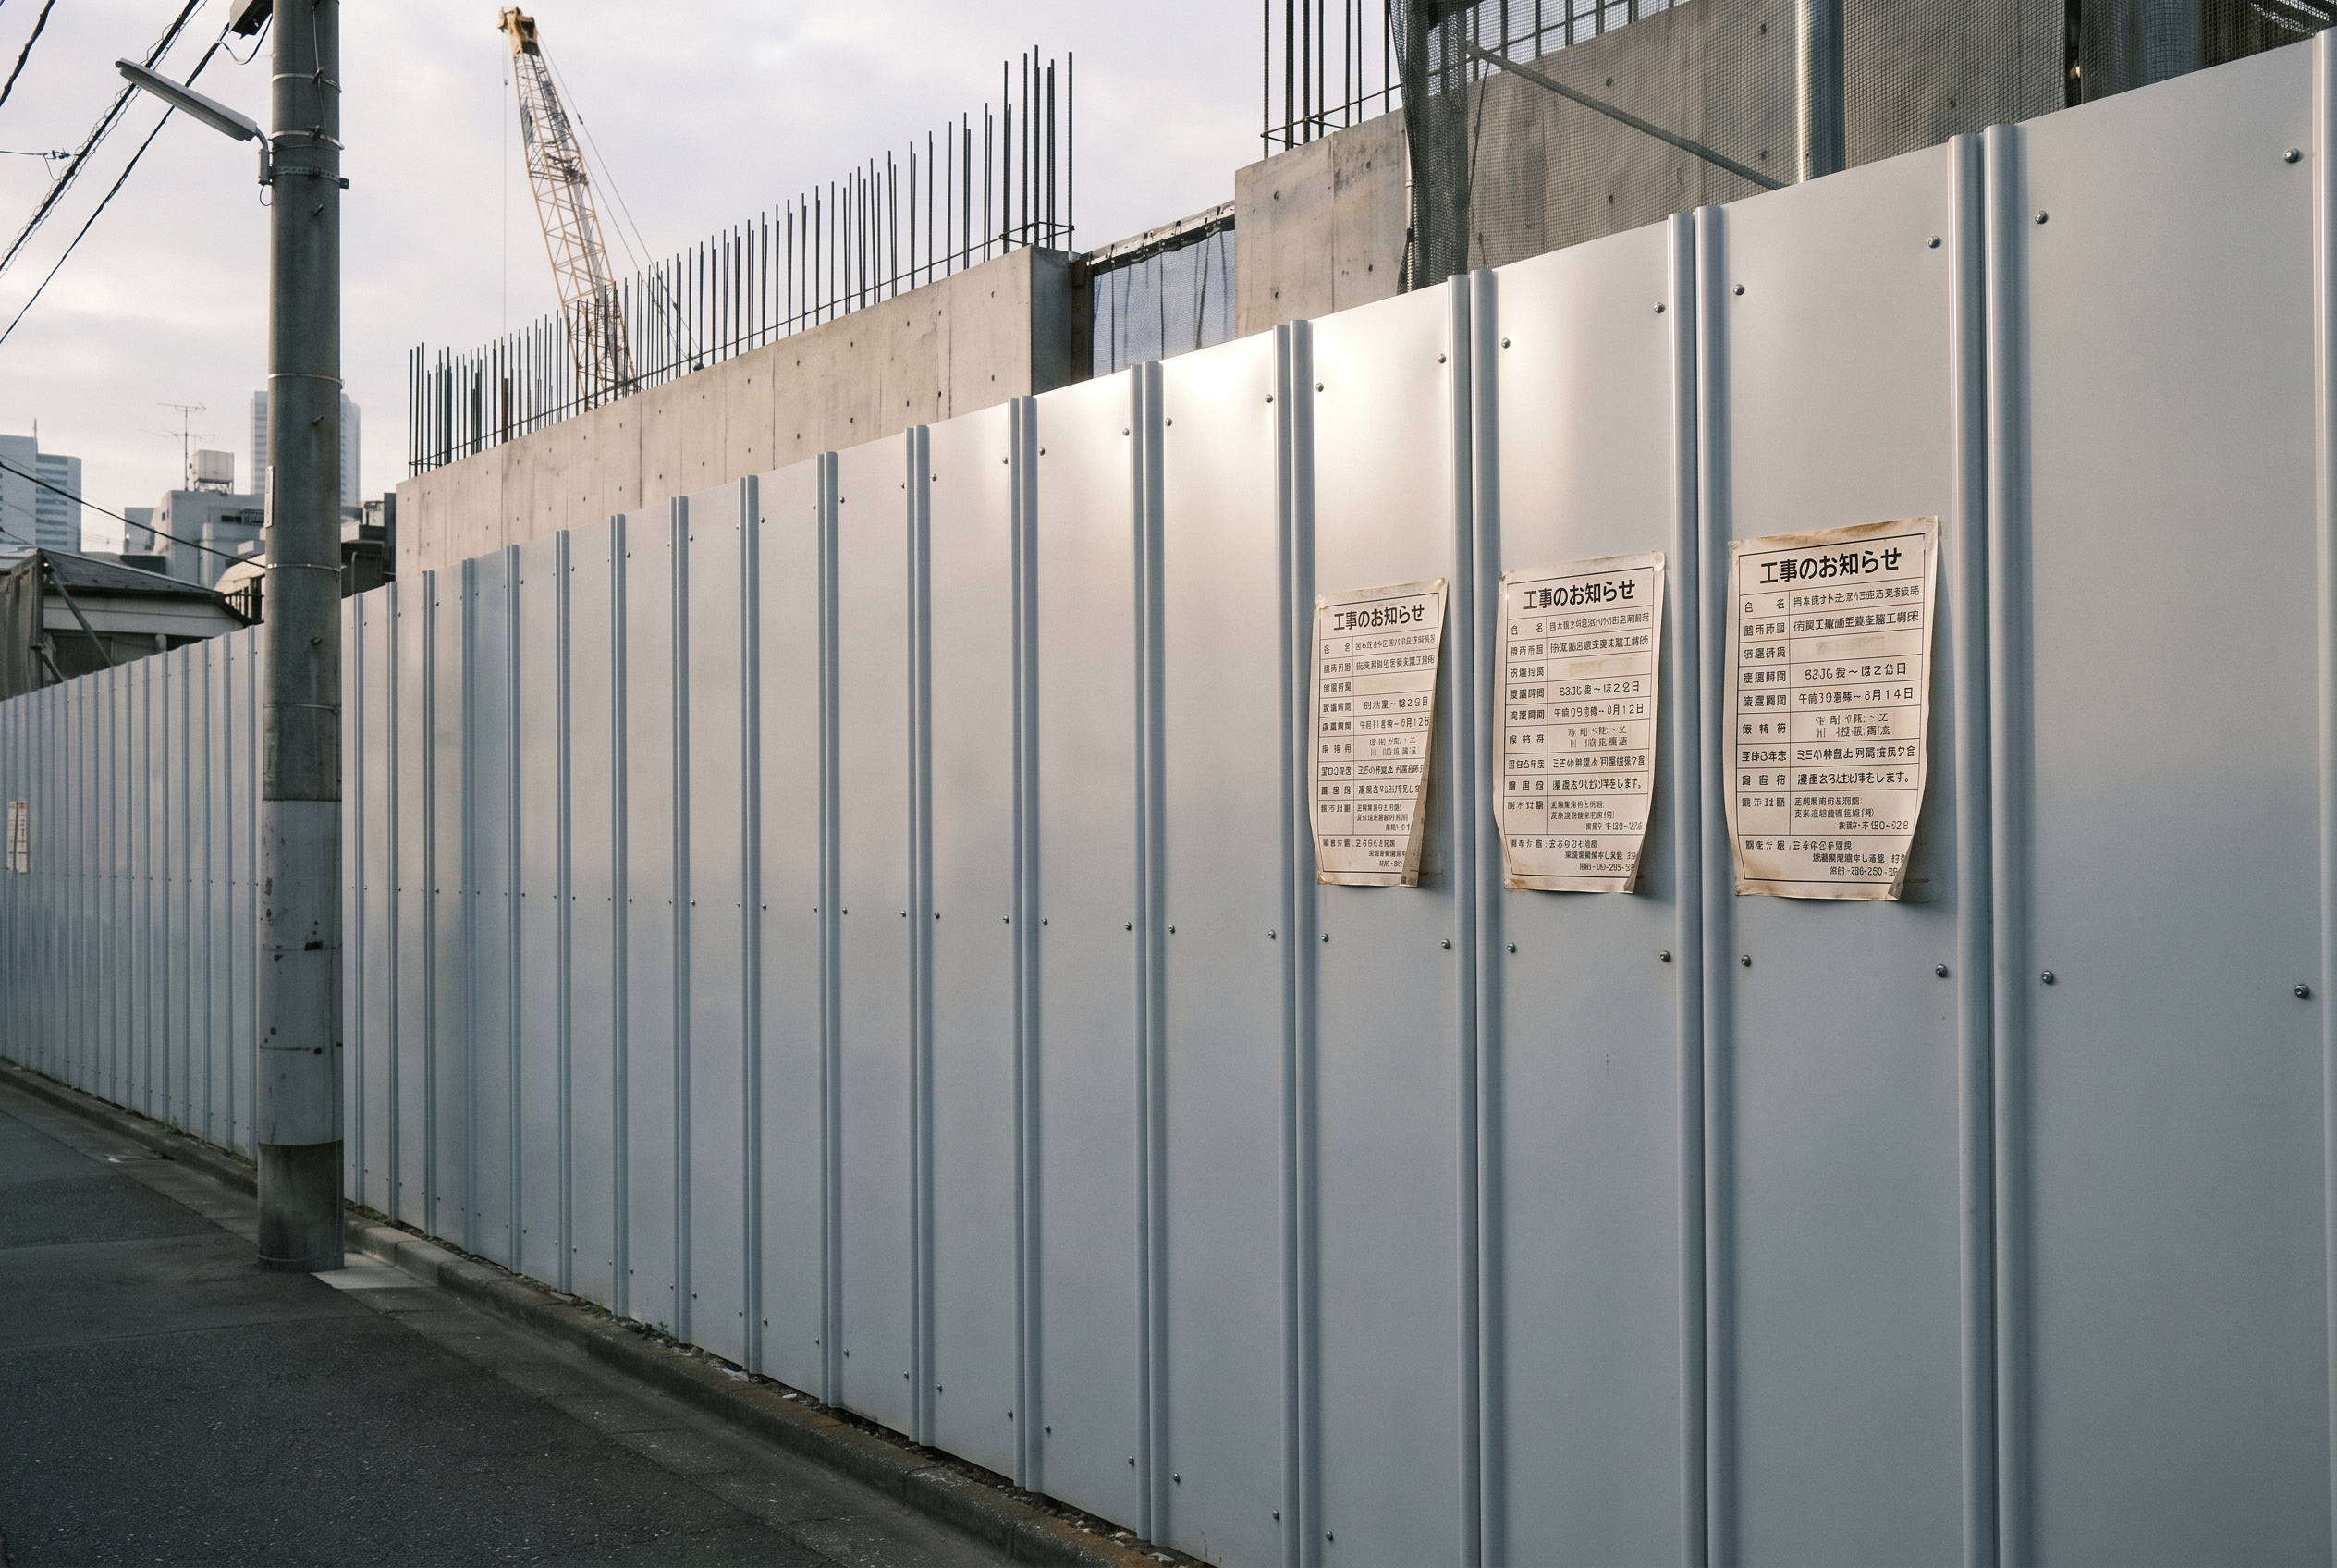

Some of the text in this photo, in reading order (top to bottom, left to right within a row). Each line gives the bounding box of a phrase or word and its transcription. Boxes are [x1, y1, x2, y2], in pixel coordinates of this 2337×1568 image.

[1759, 547, 1902, 584] 工事のお知らせ
[1523, 579, 1635, 609] 工事のお知らせ
[1333, 604, 1425, 631] 工事のお知らせ
